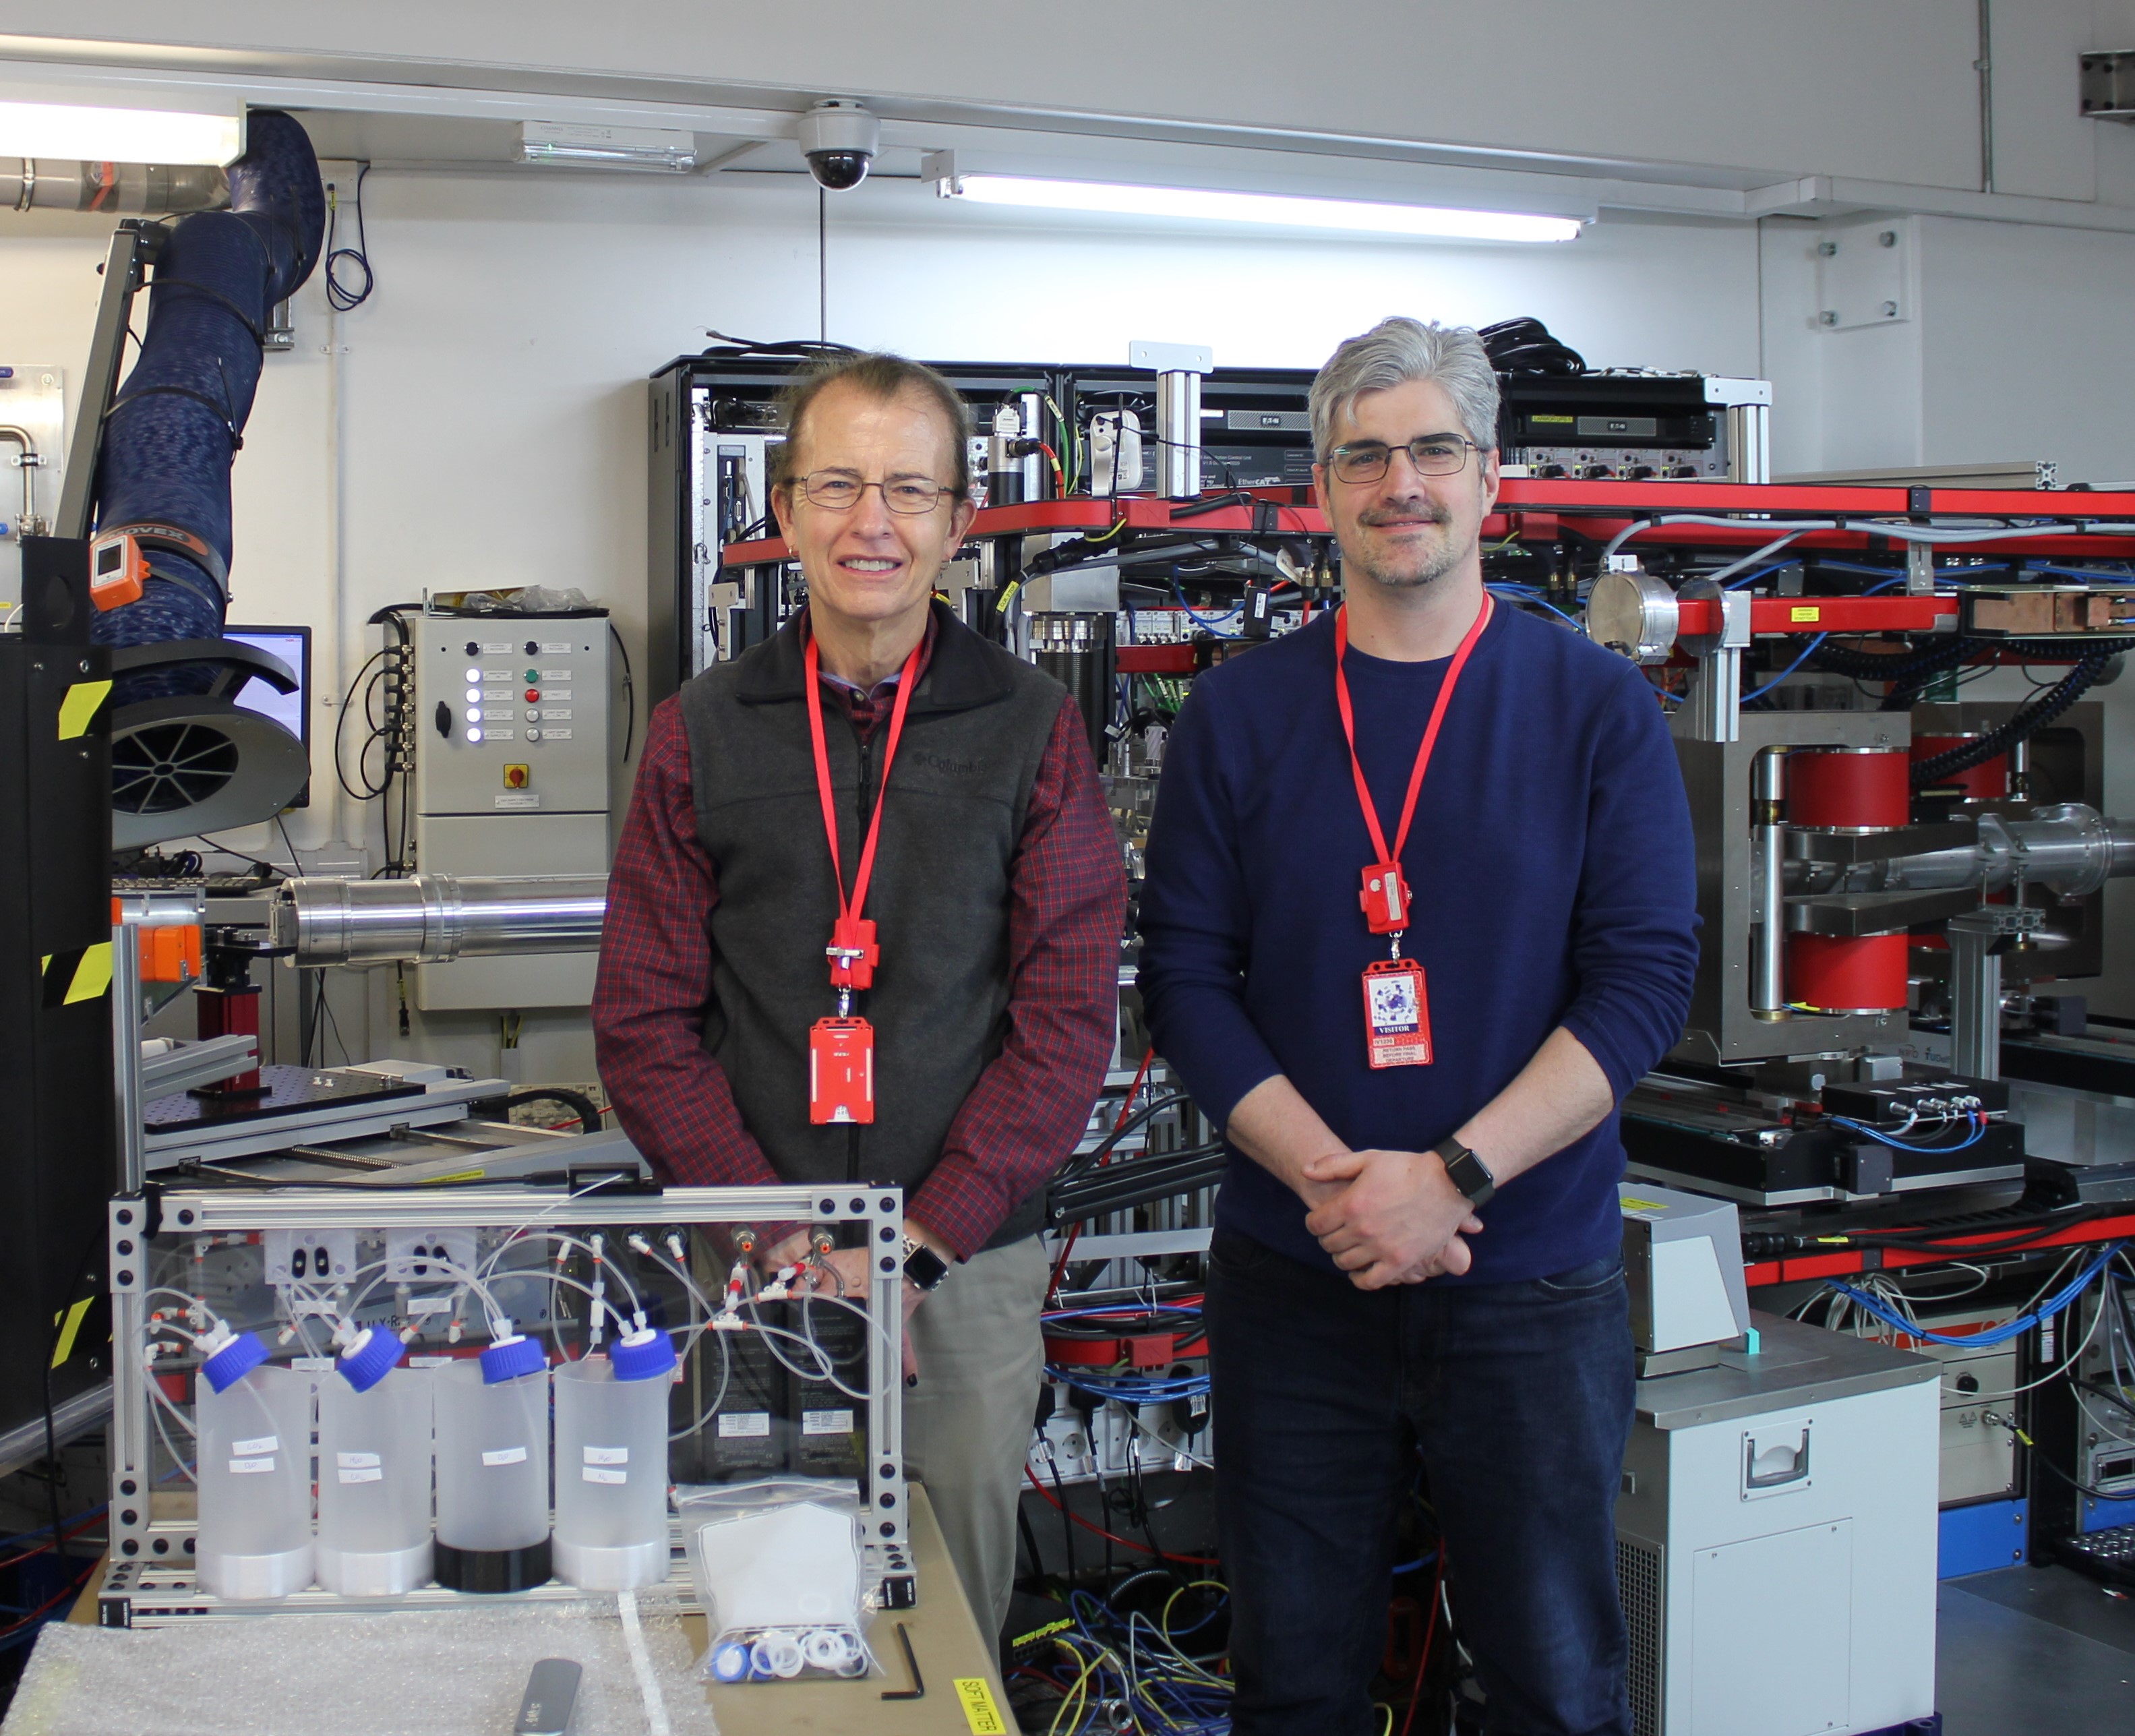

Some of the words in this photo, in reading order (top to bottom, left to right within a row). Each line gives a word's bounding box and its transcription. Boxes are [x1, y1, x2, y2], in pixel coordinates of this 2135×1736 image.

[1238, 477, 1272, 485] EtherCAT
[927, 754, 988, 774] Columbia
[1379, 1025, 1410, 1034] VISITOR
[962, 1681, 985, 1700] SOFT
[971, 1701, 997, 1732] MATTER
